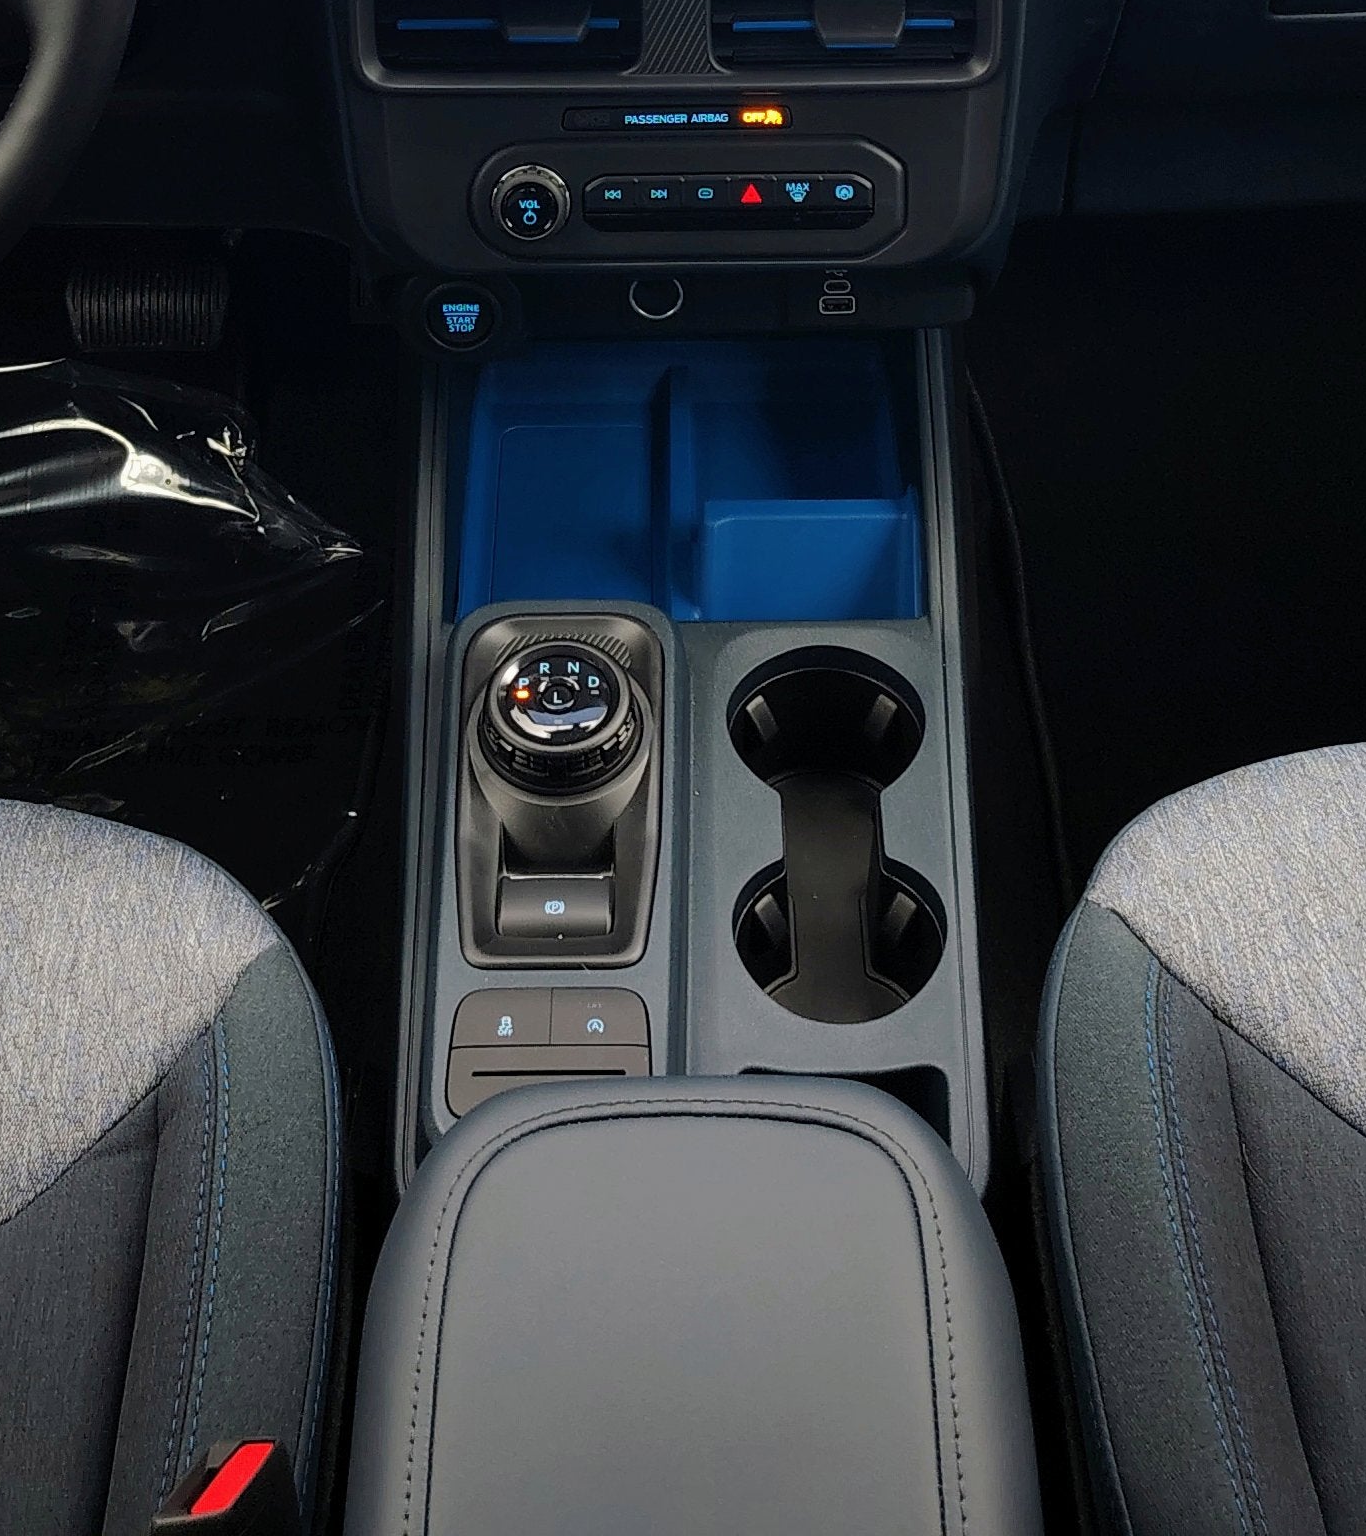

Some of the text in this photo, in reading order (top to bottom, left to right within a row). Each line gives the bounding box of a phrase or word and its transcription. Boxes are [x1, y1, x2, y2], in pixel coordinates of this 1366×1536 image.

[624, 112, 766, 125] PASSENGER AIRBAG OFF
[785, 182, 810, 192] MAX
[518, 199, 541, 209] VOL
[442, 303, 480, 312] ENGINE
[446, 316, 477, 324] START
[448, 324, 475, 333] STOP
[517, 661, 600, 690] P R N D
[553, 691, 563, 704] L
